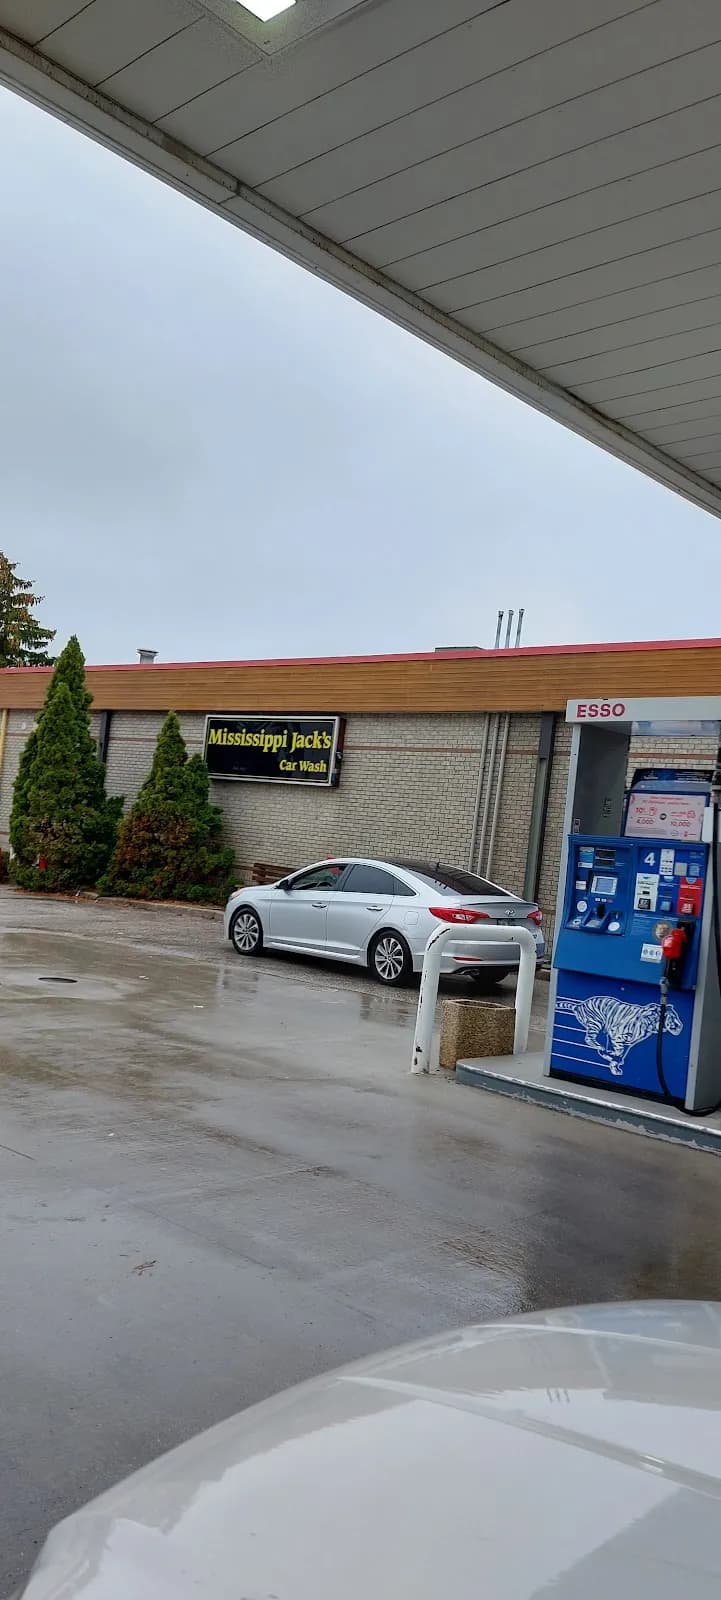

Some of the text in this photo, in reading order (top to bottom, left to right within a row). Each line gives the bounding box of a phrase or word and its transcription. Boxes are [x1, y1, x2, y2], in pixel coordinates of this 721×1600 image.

[576, 703, 625, 718] ESSO
[208, 728, 332, 753] Mississippi Jack's
[279, 759, 327, 773] Car Wash
[644, 852, 655, 866] 4
